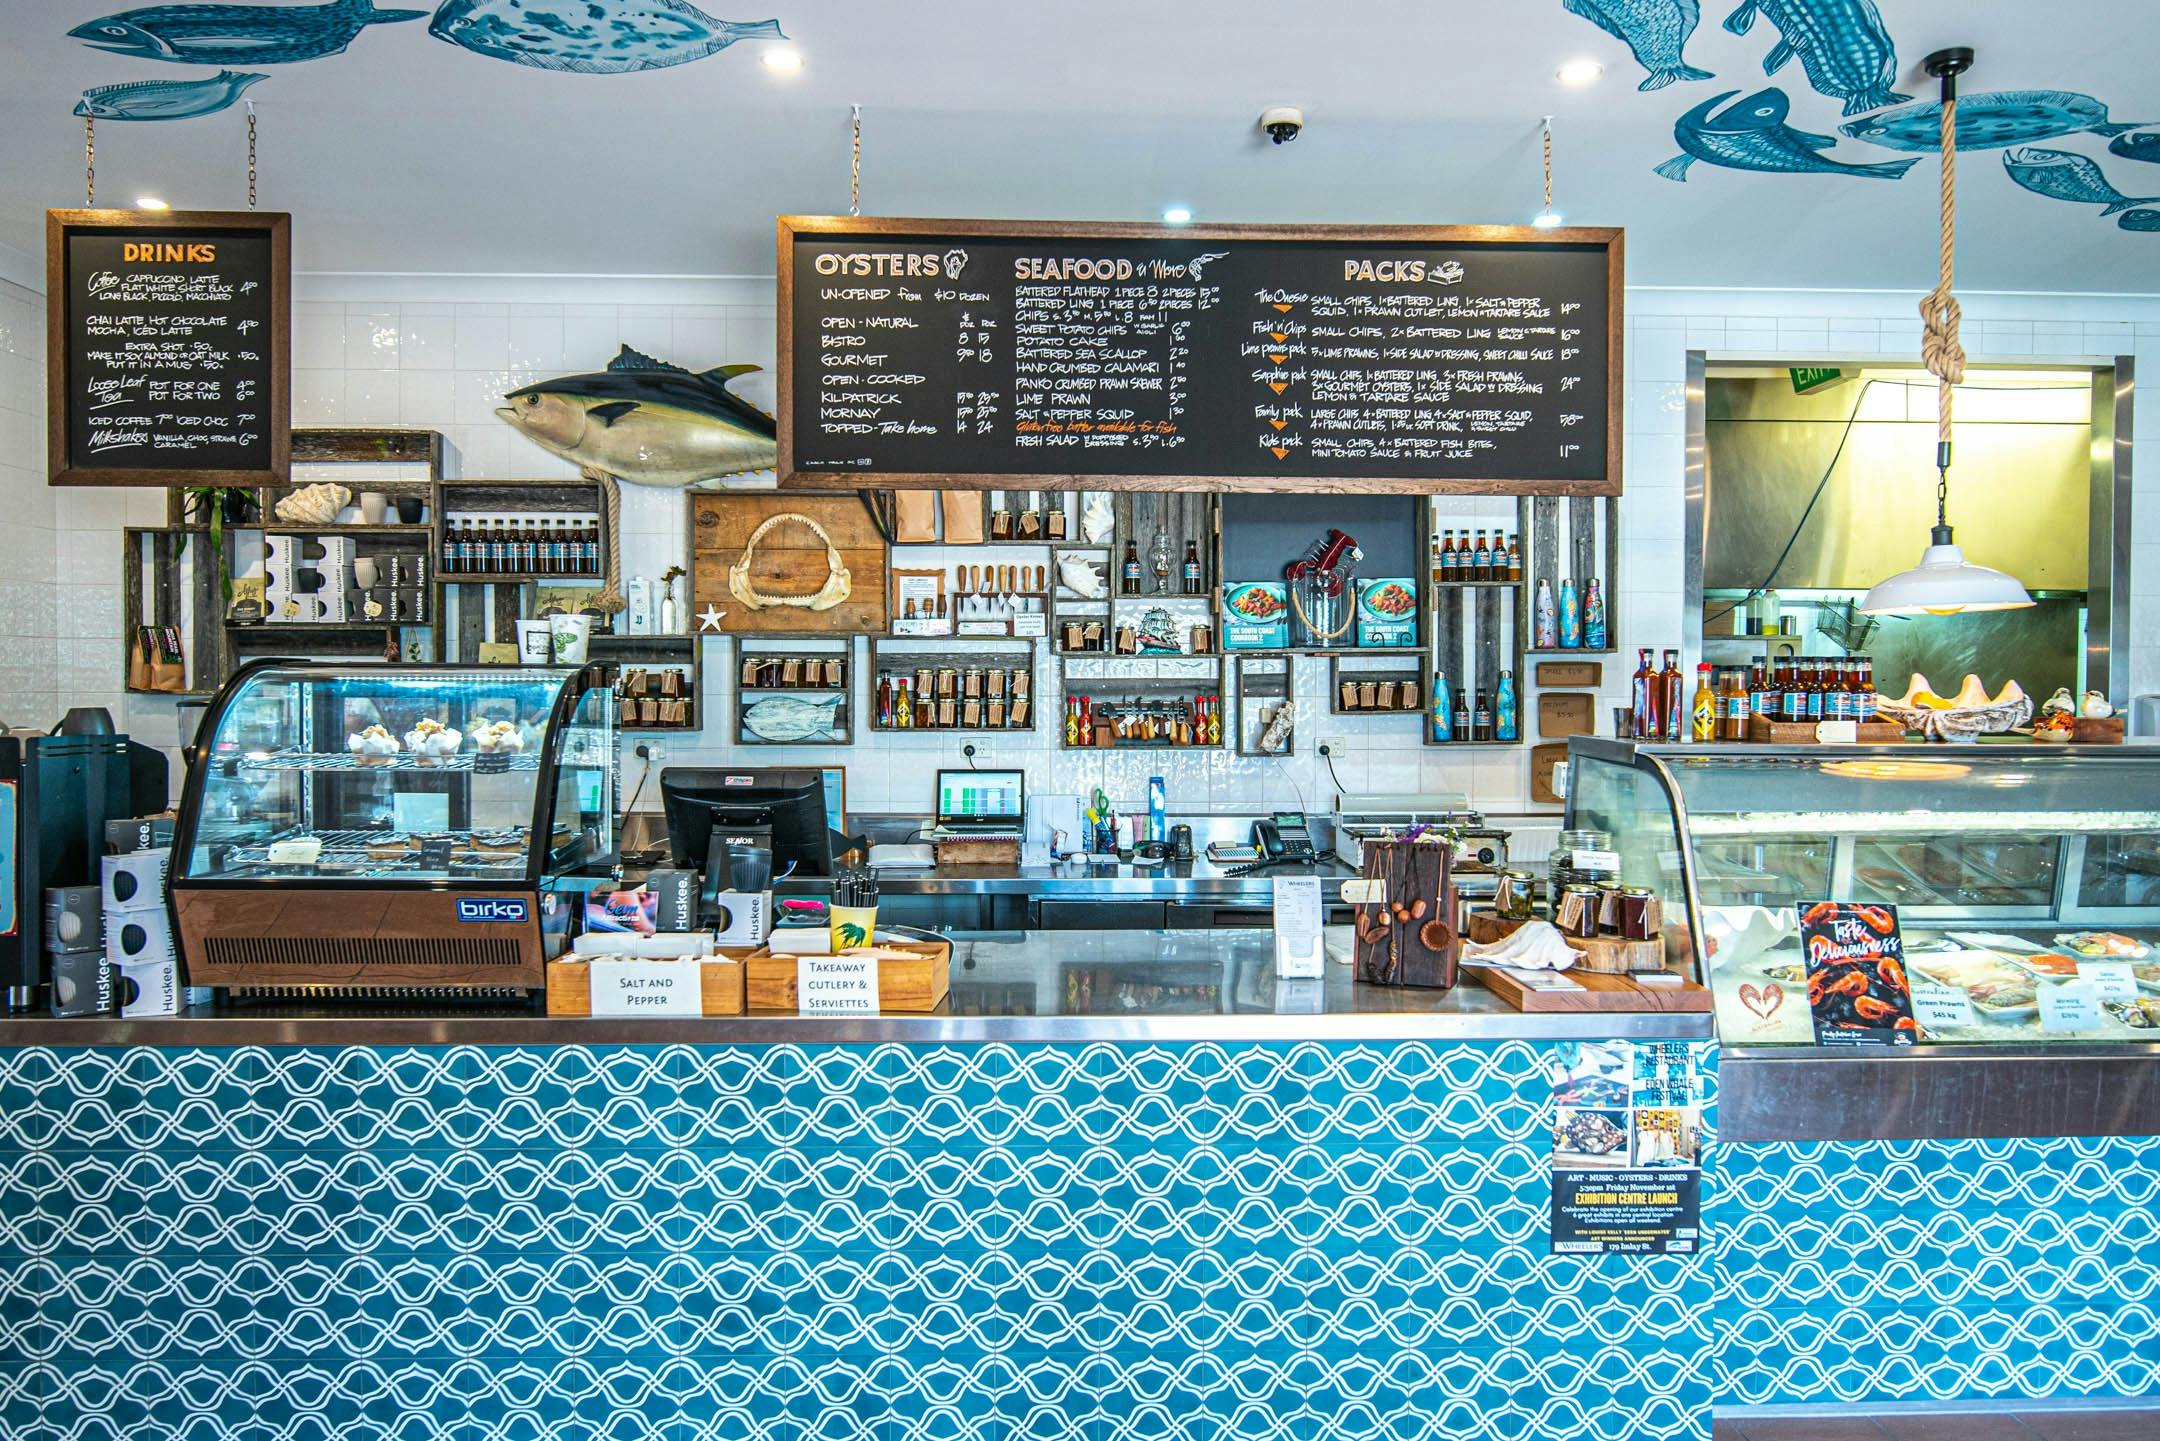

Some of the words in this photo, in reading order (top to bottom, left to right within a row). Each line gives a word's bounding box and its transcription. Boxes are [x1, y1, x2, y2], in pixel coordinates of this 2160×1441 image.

[124, 242, 216, 263] DRINKS
[815, 253, 939, 277] OYSTERS
[1014, 258, 1132, 280] SEAFOOD
[1149, 259, 1187, 279] More
[1344, 260, 1426, 282] PACKS
[821, 288, 891, 300] UN-OPENED
[1016, 286, 1062, 297] BATTERED
[1062, 286, 1110, 297] FLATHEAD
[1016, 299, 1065, 309] BATTERED
[1069, 298, 1094, 309] LING
[1110, 299, 1134, 309] PIECE
[1311, 295, 1342, 306] SMALL
[1016, 311, 1050, 321] CHIPS
[1364, 306, 1401, 316] PRAWN
[1523, 308, 1551, 318] SAUCE
[87, 316, 112, 325] CHAI
[171, 316, 227, 326] CHOCOLATE
[821, 317, 856, 328] OPEN
[865, 317, 919, 329] NATURAL
[134, 327, 157, 335] ICED
[161, 327, 193, 335] LATTE
[1016, 324, 1056, 335] SWEET
[1057, 325, 1095, 335] POTATO
[1098, 324, 1128, 335] CHIPS
[1311, 327, 1346, 337] SMALL
[1406, 326, 1462, 338] BATTERED
[1466, 328, 1492, 339] LING
[821, 335, 865, 348] BISTRO
[958, 333, 968, 344] 8
[1016, 336, 1064, 346] POTATO
[1069, 337, 1109, 346] CAKE
[88, 352, 112, 360] MAKE
[209, 352, 230, 360] MILK
[821, 353, 888, 366] GOURMET
[1016, 348, 1073, 359] BATTERED
[1075, 349, 1096, 360] SEA
[1100, 349, 1147, 359] SCALLOP
[1530, 348, 1554, 360] SAUCE
[1016, 362, 1047, 374] HAND
[1049, 363, 1101, 373] CRUMBED
[1104, 363, 1159, 373] CALAMARI
[822, 375, 859, 385] OPEN
[867, 375, 926, 385] COOKED
[1311, 370, 1337, 381] SMALL
[1374, 370, 1413, 381] BATTERED
[1457, 370, 1484, 382] FRESH
[150, 382, 170, 390] POT
[174, 382, 195, 390] FOR
[198, 382, 221, 390] ONE
[1016, 378, 1052, 390] PANKO
[1055, 379, 1096, 390] CRUMBED
[1100, 379, 1129, 390] PRAWN
[1130, 378, 1163, 390] SKEWER
[1455, 382, 1486, 392] SALAD
[1498, 384, 1543, 394] DRESSING
[149, 391, 170, 400] POT
[173, 392, 194, 400] FOR
[195, 392, 221, 400] TWO
[821, 391, 902, 404] KILPATRICK
[1016, 394, 1043, 405] LIME
[1051, 394, 1091, 404] PRAWN
[1312, 392, 1347, 401] LEMON
[1360, 393, 1409, 402] TARTARE
[1414, 392, 1450, 403] SAUCE
[821, 407, 881, 419] MORNAY
[1015, 410, 1040, 420] SALT
[1050, 410, 1092, 419] PEPPER
[1096, 410, 1135, 420] SQUID
[1311, 409, 1336, 419] LARGE
[1376, 410, 1411, 419] BATTERED
[1472, 410, 1501, 421] PEPPER
[88, 417, 112, 425] ICED
[115, 417, 153, 425] COFFEE
[176, 417, 200, 425] ICED
[1323, 420, 1351, 430] PRAWN
[1016, 435, 1043, 447] FRESH
[1046, 435, 1079, 446] SALAD
[1311, 438, 1342, 447] SMALL
[1441, 440, 1462, 448] FISH
[1312, 449, 1330, 458] MINI
[1331, 449, 1366, 458] TOMATO
[1370, 448, 1400, 458] SAUCE
[1414, 450, 1442, 458] FRUIT
[1445, 450, 1473, 458] JUICE
[461, 902, 523, 916] birko
[675, 878, 688, 929] Huskee.
[751, 897, 760, 940] Huskee.
[1829, 918, 1869, 942] Taste
[162, 965, 172, 1011] Huskee.
[858, 979, 868, 990] &
[1575, 1193, 1617, 1204] EXHIBITION
[1619, 1193, 1647, 1204] CENTRE
[1648, 1193, 1678, 1204] LAUNCH
